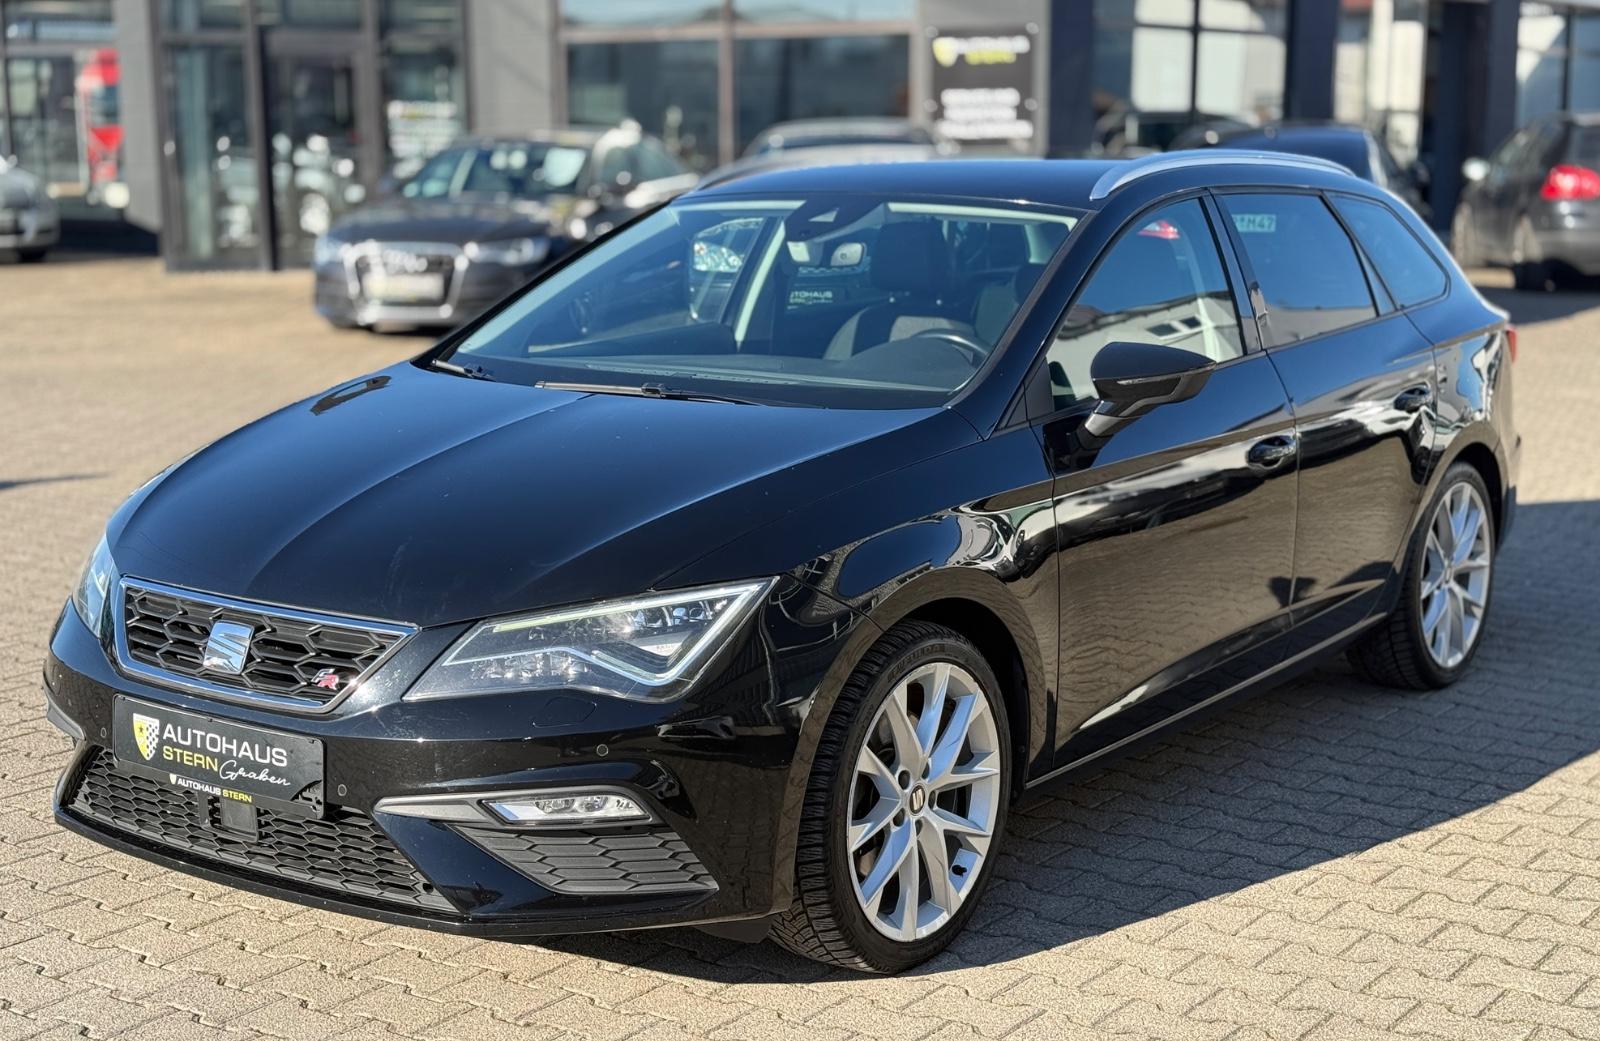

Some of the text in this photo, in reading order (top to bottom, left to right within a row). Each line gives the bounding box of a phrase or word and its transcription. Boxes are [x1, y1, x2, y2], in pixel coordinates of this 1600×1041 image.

[162, 723, 288, 767] AUTOHAUS
[162, 745, 291, 786] STERN Graben
[177, 778, 252, 803] AUTOHAUS STERN
